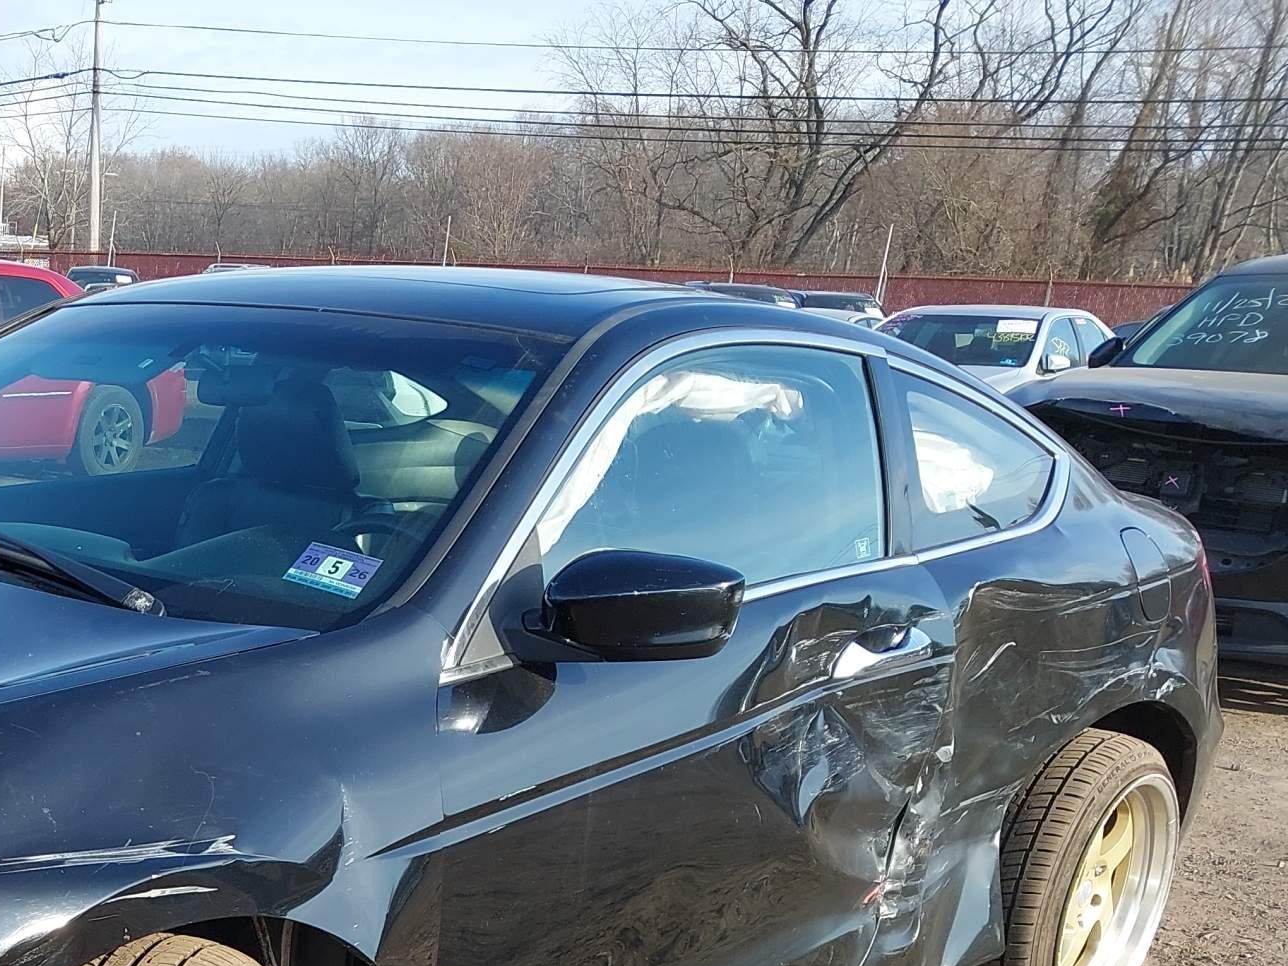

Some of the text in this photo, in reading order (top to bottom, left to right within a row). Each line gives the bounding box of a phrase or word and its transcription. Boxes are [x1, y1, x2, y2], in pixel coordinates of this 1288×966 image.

[302, 555, 320, 566] 20
[328, 560, 343, 575] 5
[349, 568, 369, 580] 26
